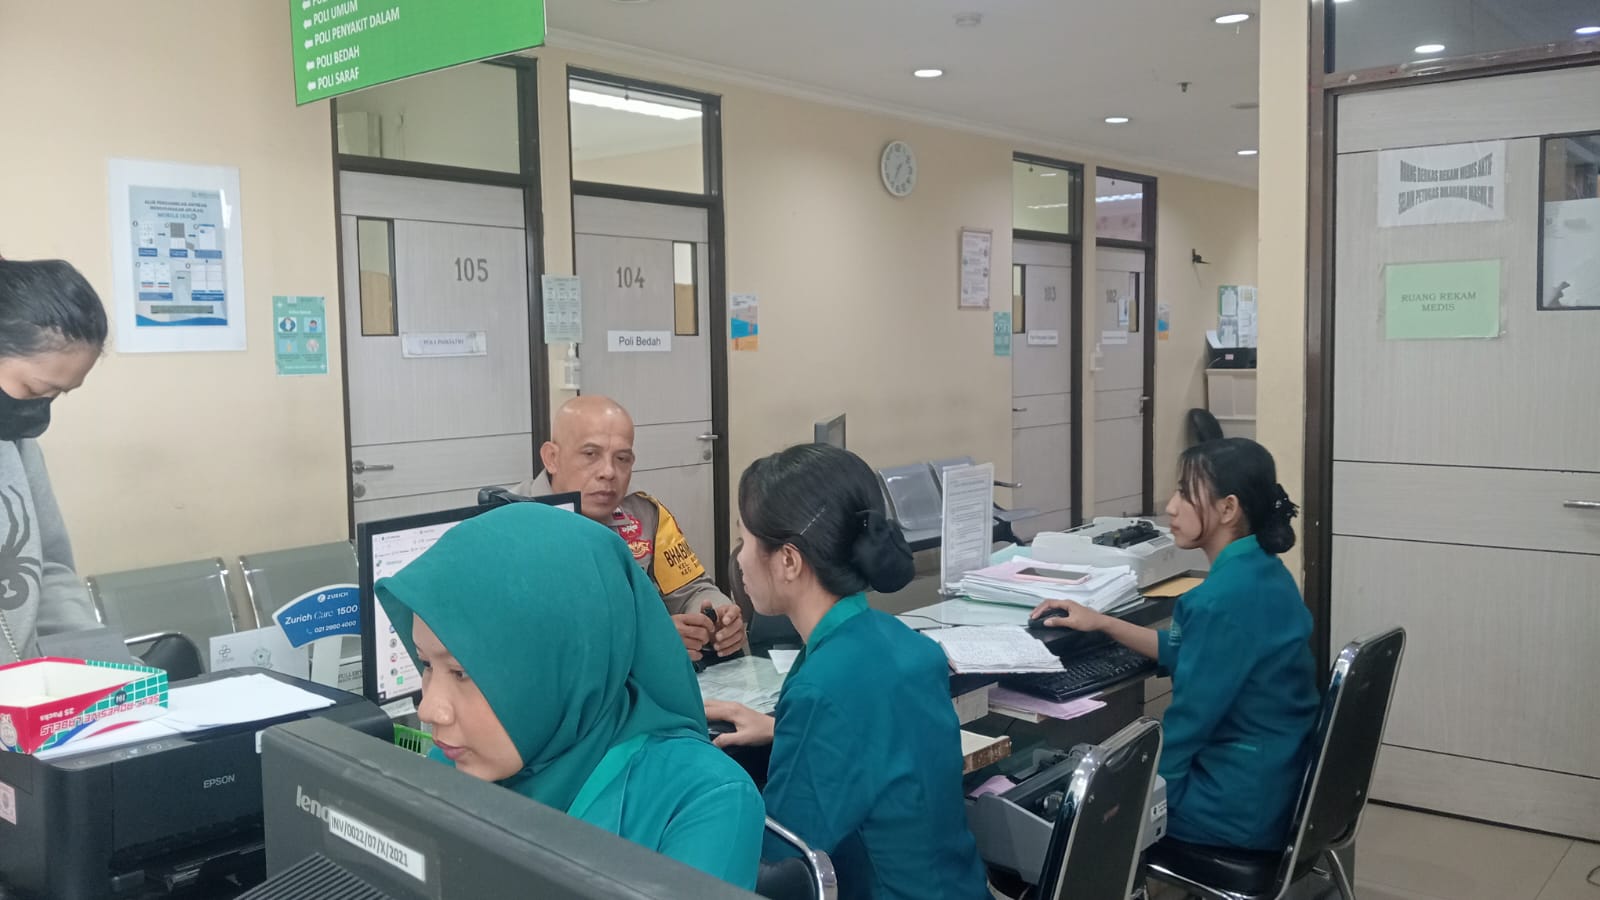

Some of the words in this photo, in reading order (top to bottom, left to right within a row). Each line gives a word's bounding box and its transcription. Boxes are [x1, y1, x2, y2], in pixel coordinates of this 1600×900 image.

[313, 9, 330, 25] POLI
[331, 0, 358, 19] UMUM
[314, 30, 331, 46] POLI
[332, 17, 367, 40] PENYAKIT
[370, 7, 400, 27] DALAM
[316, 54, 332, 69] POLI
[333, 46, 360, 65] BEDAH
[318, 75, 334, 90] POLI
[335, 67, 360, 85] SARAF
[1439, 167, 1459, 182] REKAM
[454, 257, 489, 283] 105
[616, 266, 646, 290] 104
[1401, 293, 1436, 303] RUANG
[1439, 291, 1477, 301] REKAM
[1421, 303, 1456, 312] MEDIS
[618, 335, 635, 347] Poli
[636, 335, 662, 347] Bedah
[326, 591, 349, 600] ZURICH
[285, 612, 312, 625] Zurich
[313, 610, 334, 620] Care
[336, 604, 358, 616] 1500
[39, 709, 63, 721] Packs
[63, 707, 75, 716] 25
[40, 715, 84, 737] LABELS
[203, 773, 235, 789] EPSON
[296, 784, 330, 823] leno
[331, 816, 409, 868] INV/0022/07/X/2021
